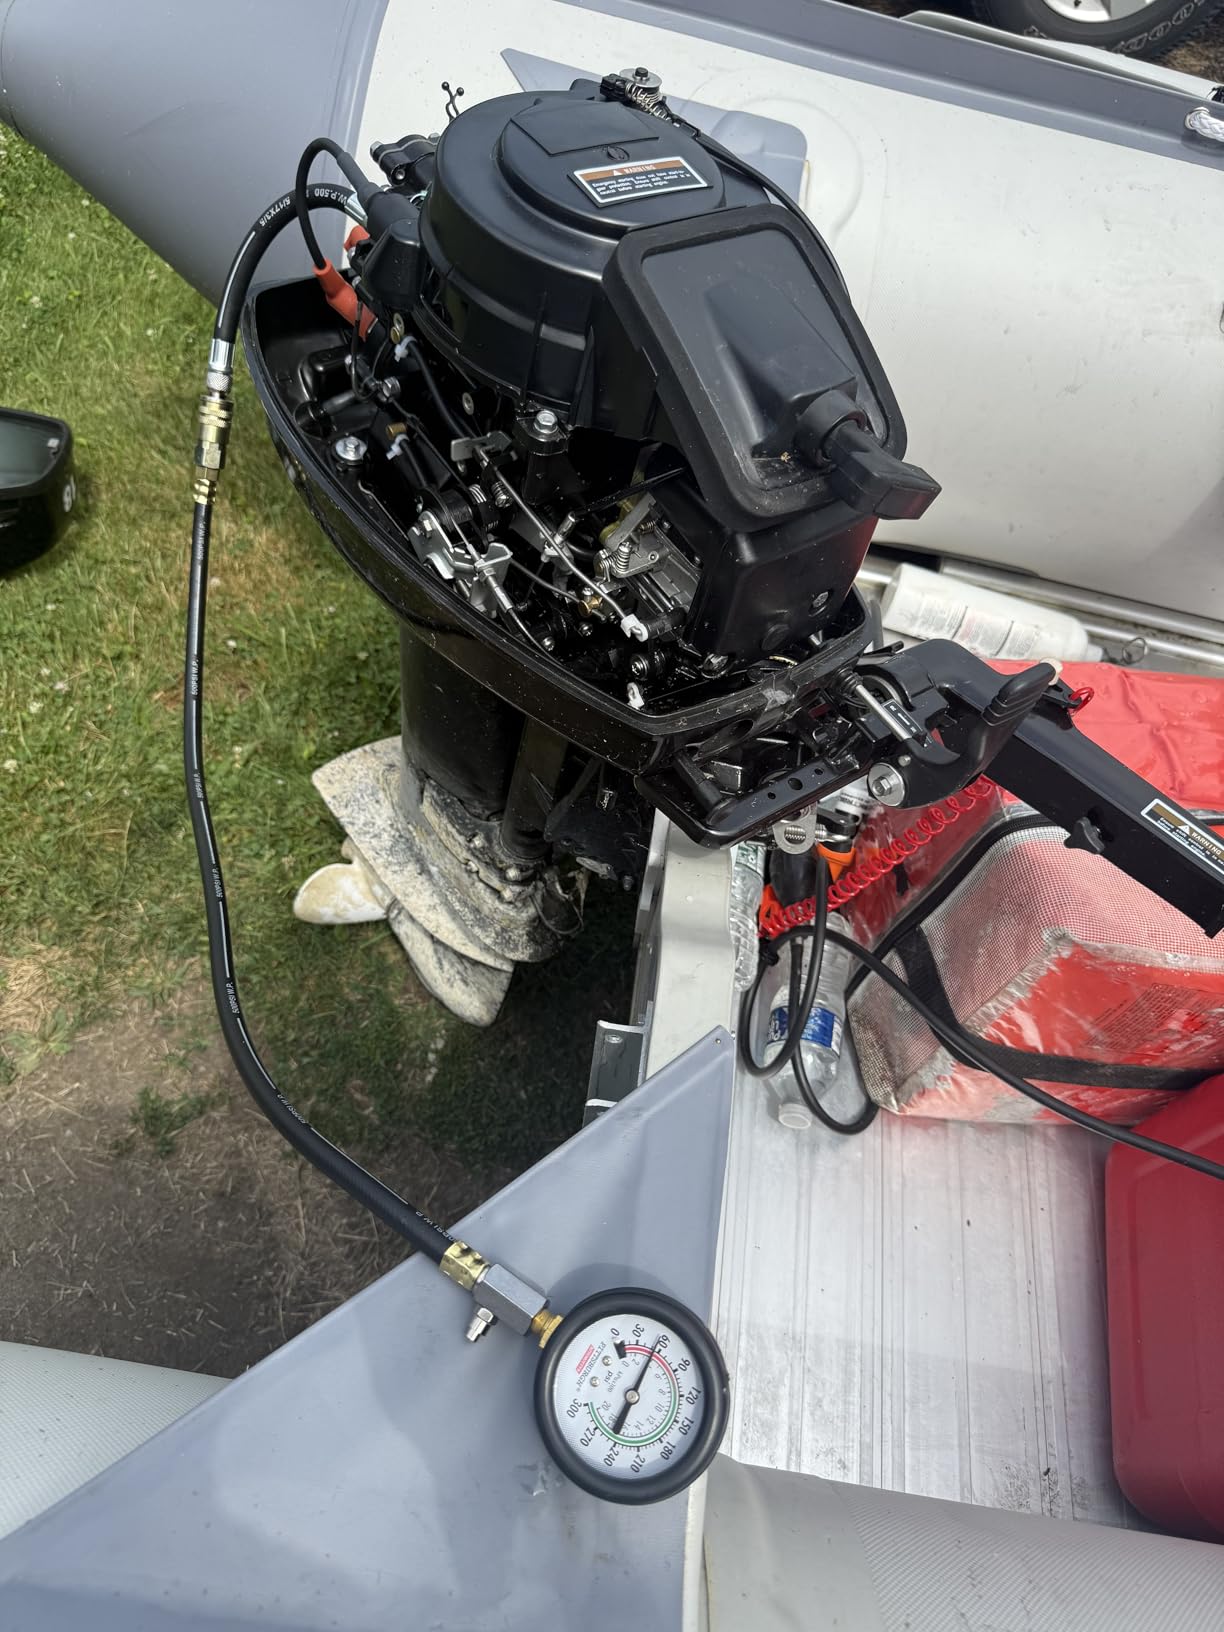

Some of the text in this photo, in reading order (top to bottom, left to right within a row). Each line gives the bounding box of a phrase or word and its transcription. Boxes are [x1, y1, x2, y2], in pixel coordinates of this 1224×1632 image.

[623, 165, 656, 174] WARNING
[1192, 832, 1222, 855] WARNING
[610, 1328, 620, 1336] 0
[632, 1323, 644, 1338] 30
[658, 1334, 671, 1349] 60
[677, 1358, 691, 1371] 90
[604, 1370, 613, 1385] psi
[685, 1386, 702, 1405] 120
[566, 1398, 582, 1418] 300
[602, 1400, 611, 1411] 20
[655, 1402, 665, 1413] 10
[635, 1420, 644, 1430] 14
[646, 1415, 656, 1425] 12
[678, 1417, 694, 1435] 150
[580, 1427, 595, 1447] 270
[603, 1447, 619, 1467] 240
[660, 1441, 676, 1460] 180
[630, 1454, 646, 1473] 210
